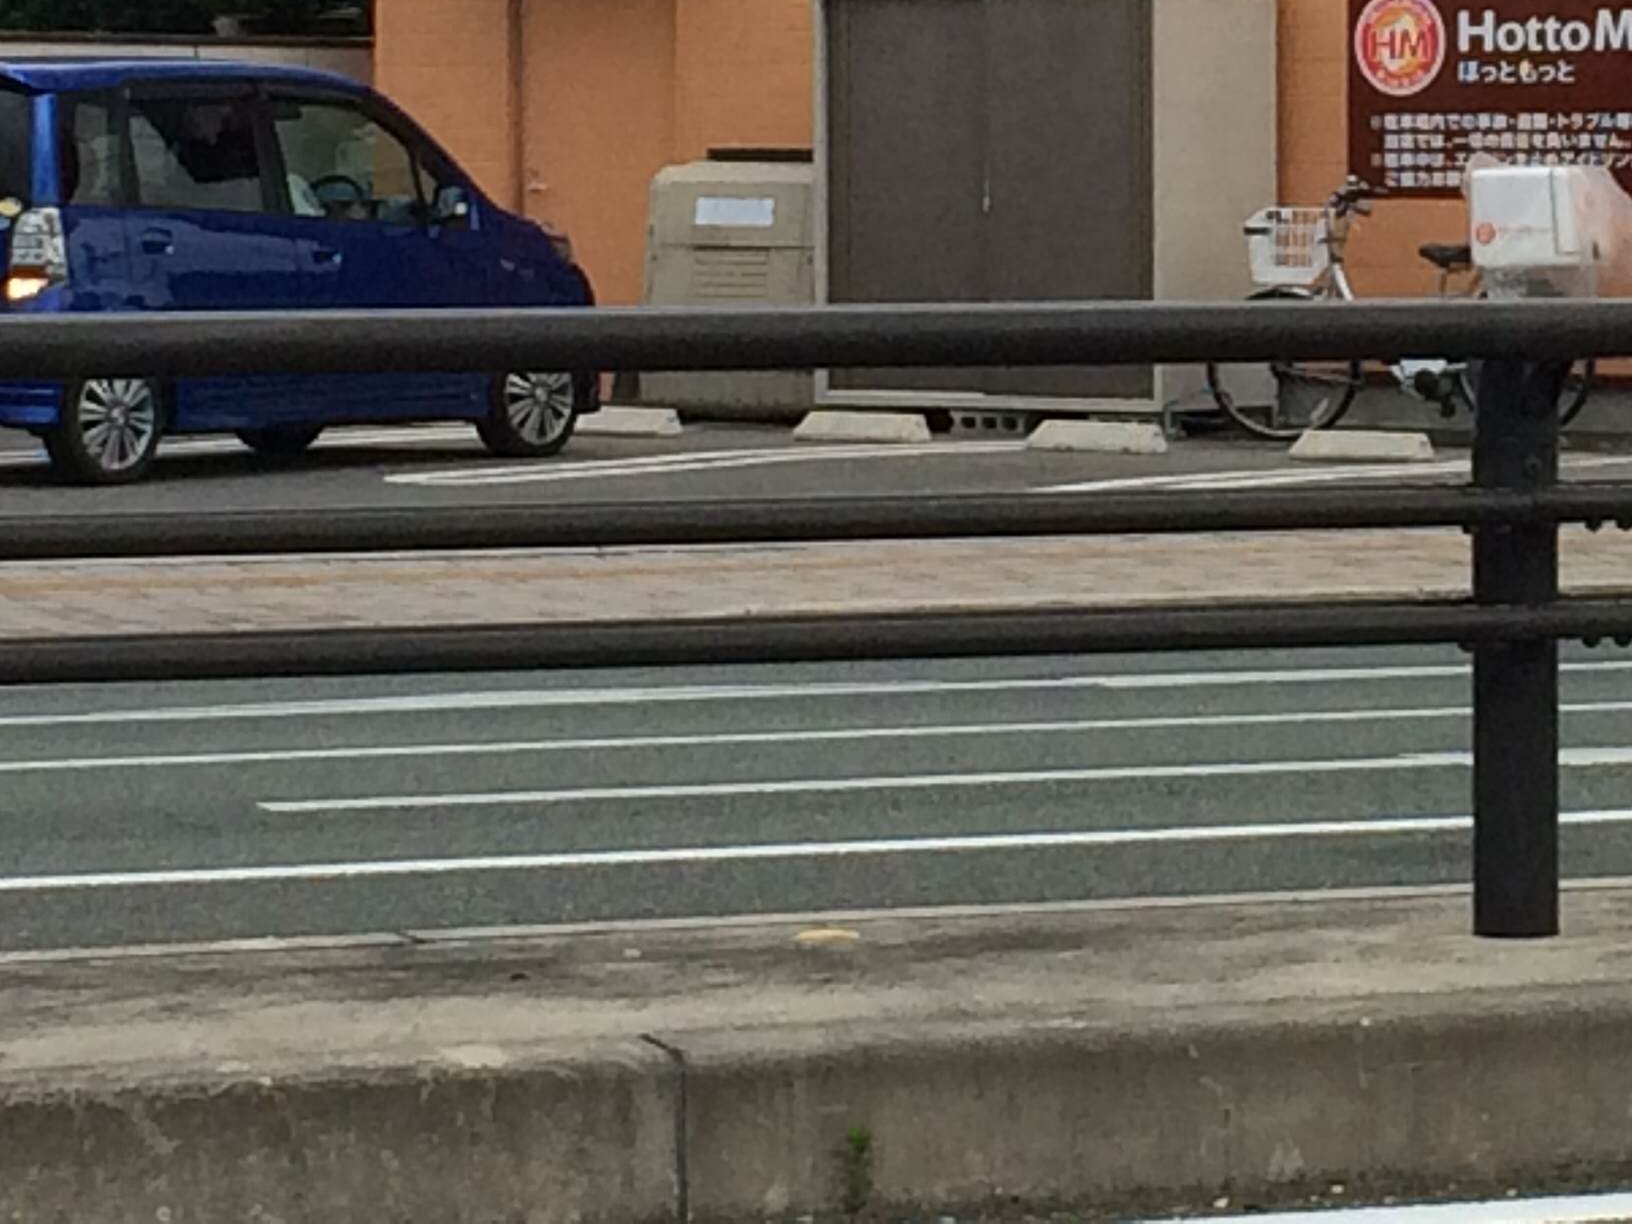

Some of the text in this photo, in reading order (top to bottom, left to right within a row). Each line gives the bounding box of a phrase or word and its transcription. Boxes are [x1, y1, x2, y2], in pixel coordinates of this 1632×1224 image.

[1457, 59, 1575, 83] ほっともっと
